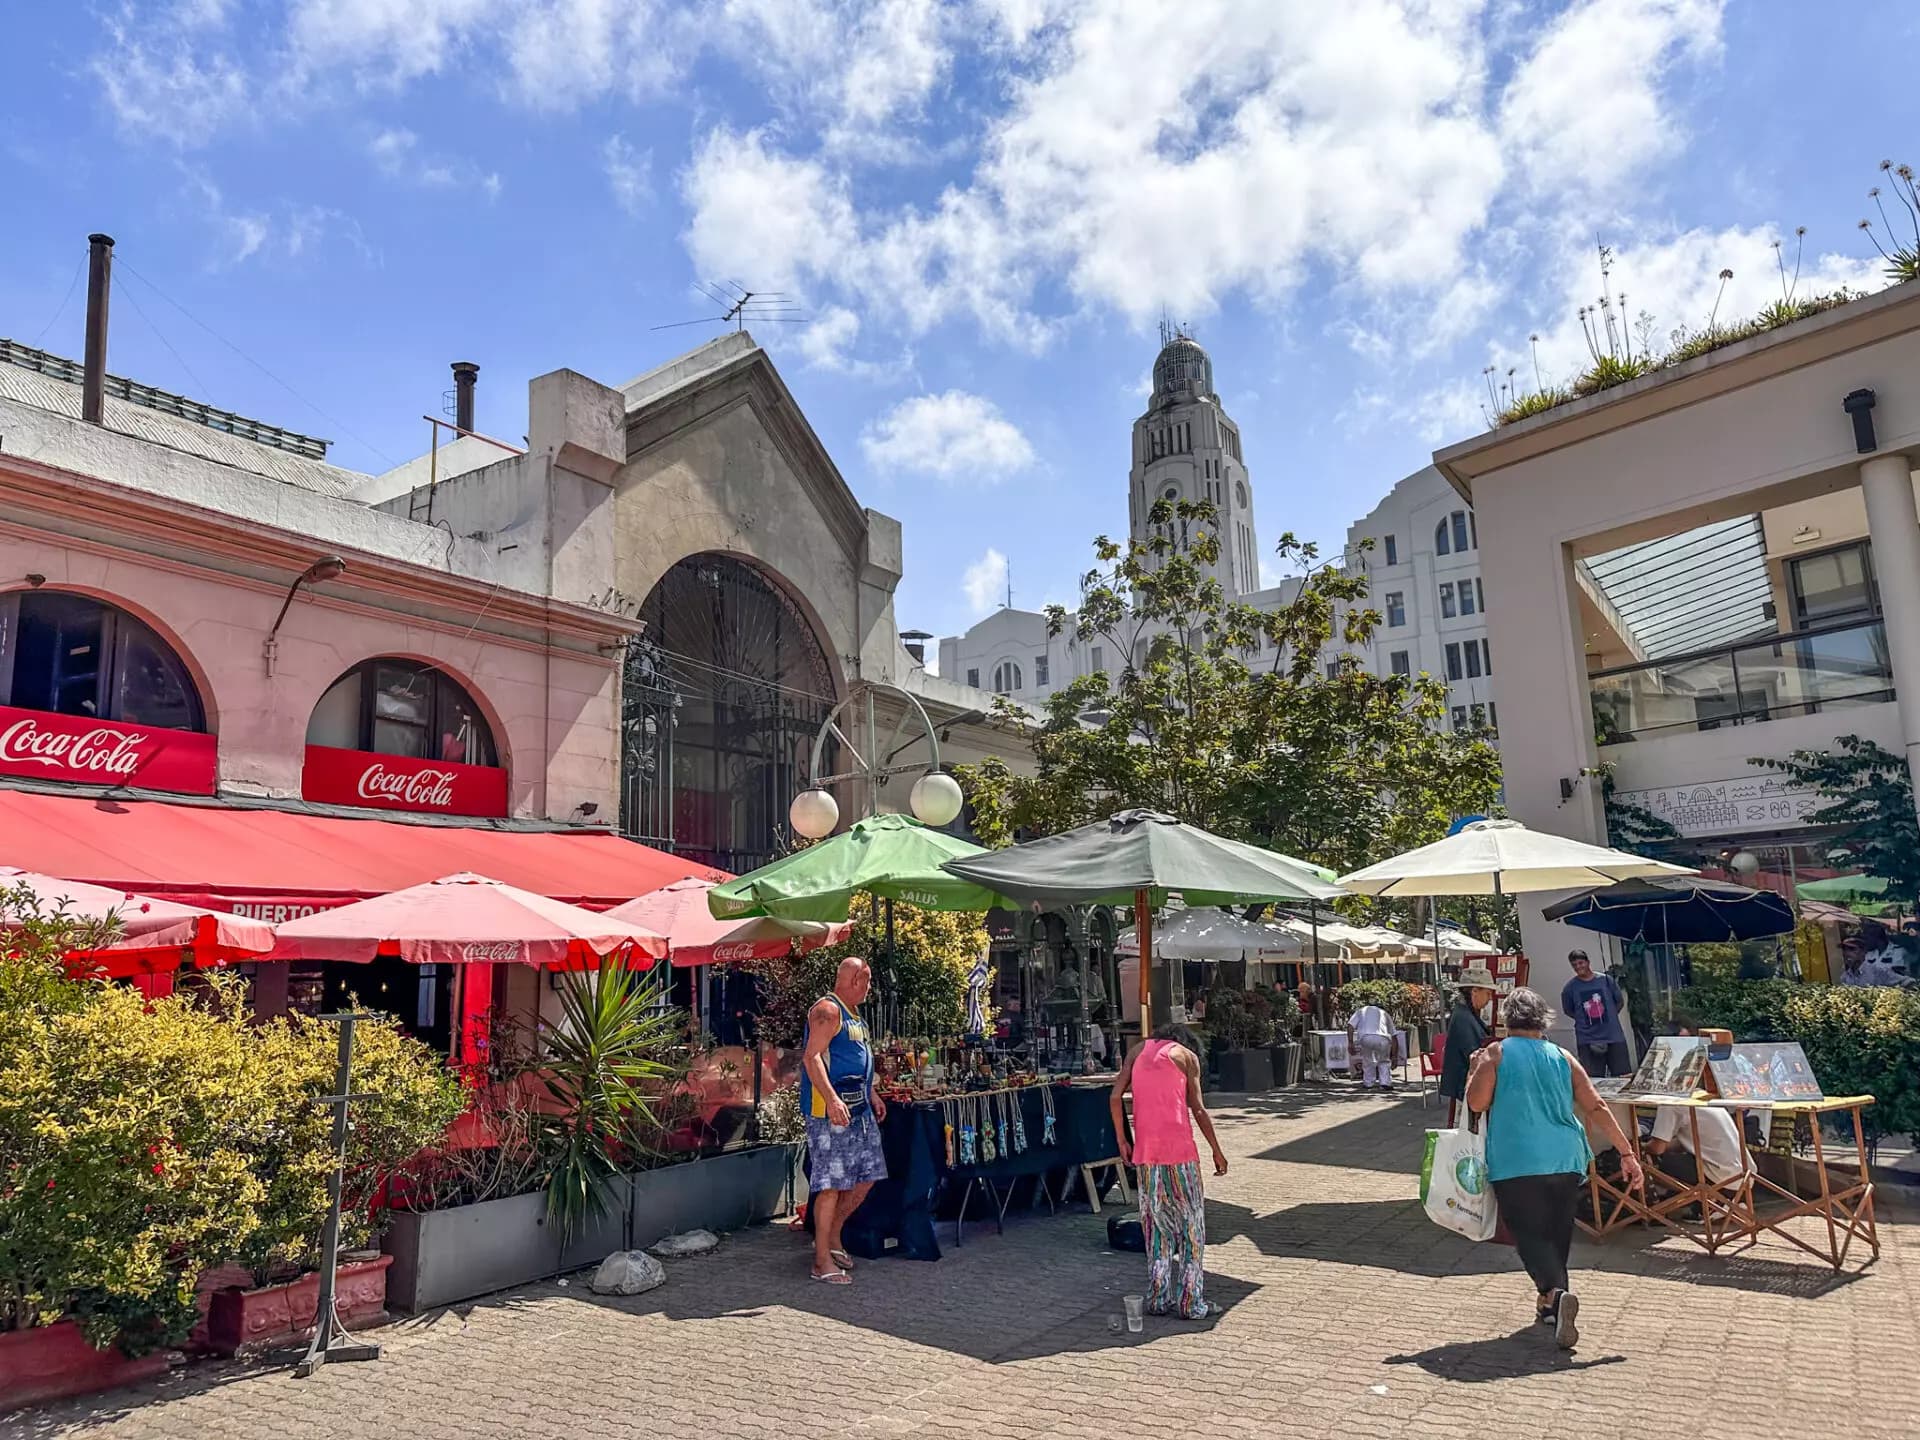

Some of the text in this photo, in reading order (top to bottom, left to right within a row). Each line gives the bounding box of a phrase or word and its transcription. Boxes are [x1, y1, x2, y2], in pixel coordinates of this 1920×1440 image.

[0, 719, 148, 774] Coca-Cola
[358, 763, 457, 806] Coca-Cola
[899, 889, 939, 906] SALUS
[232, 903, 315, 923] PUERTO
[463, 942, 520, 961] Coca-Cola
[713, 943, 755, 961] Coca-Cola
